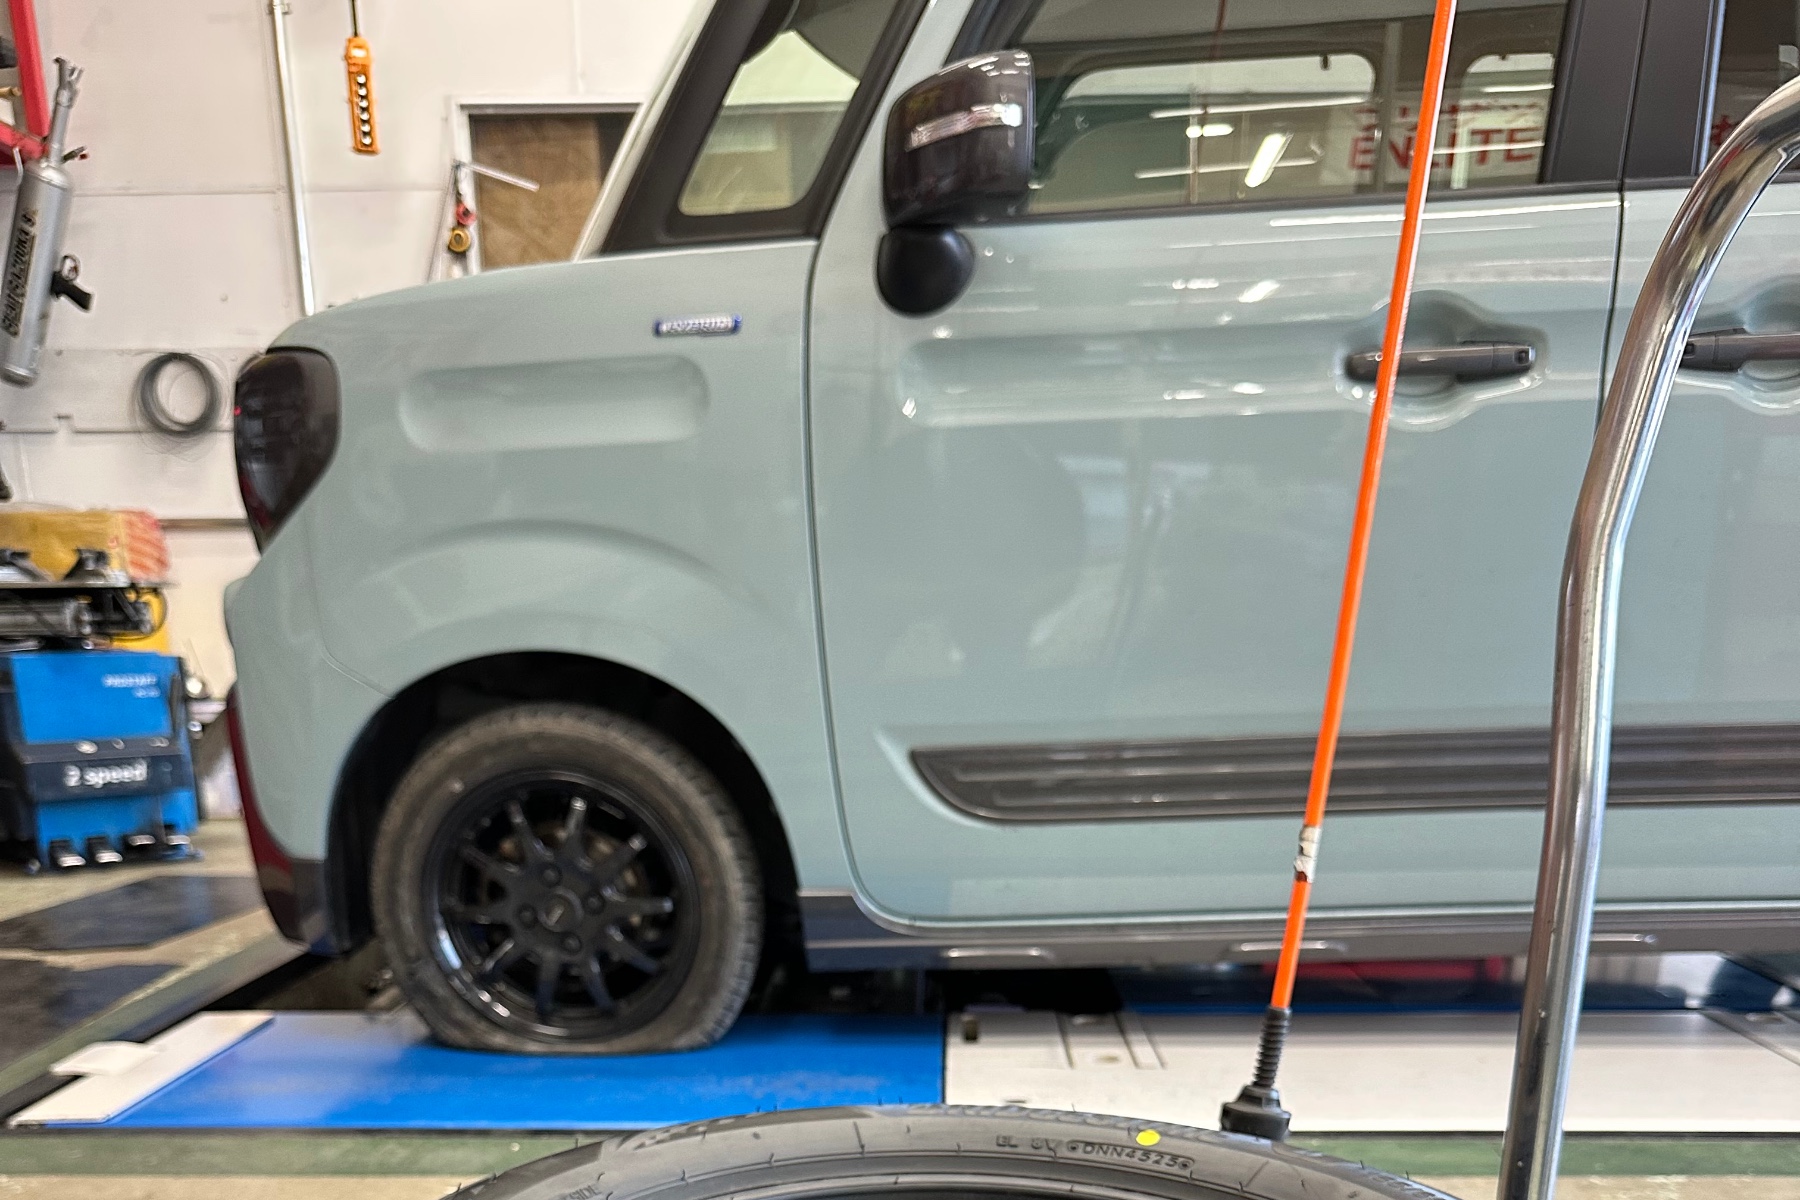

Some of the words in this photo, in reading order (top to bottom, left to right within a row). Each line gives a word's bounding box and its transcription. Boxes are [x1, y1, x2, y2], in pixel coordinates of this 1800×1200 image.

[1349, 126, 1546, 170] ENITE
[82, 758, 148, 788] speed
[1082, 1143, 1178, 1169] DNN4525
